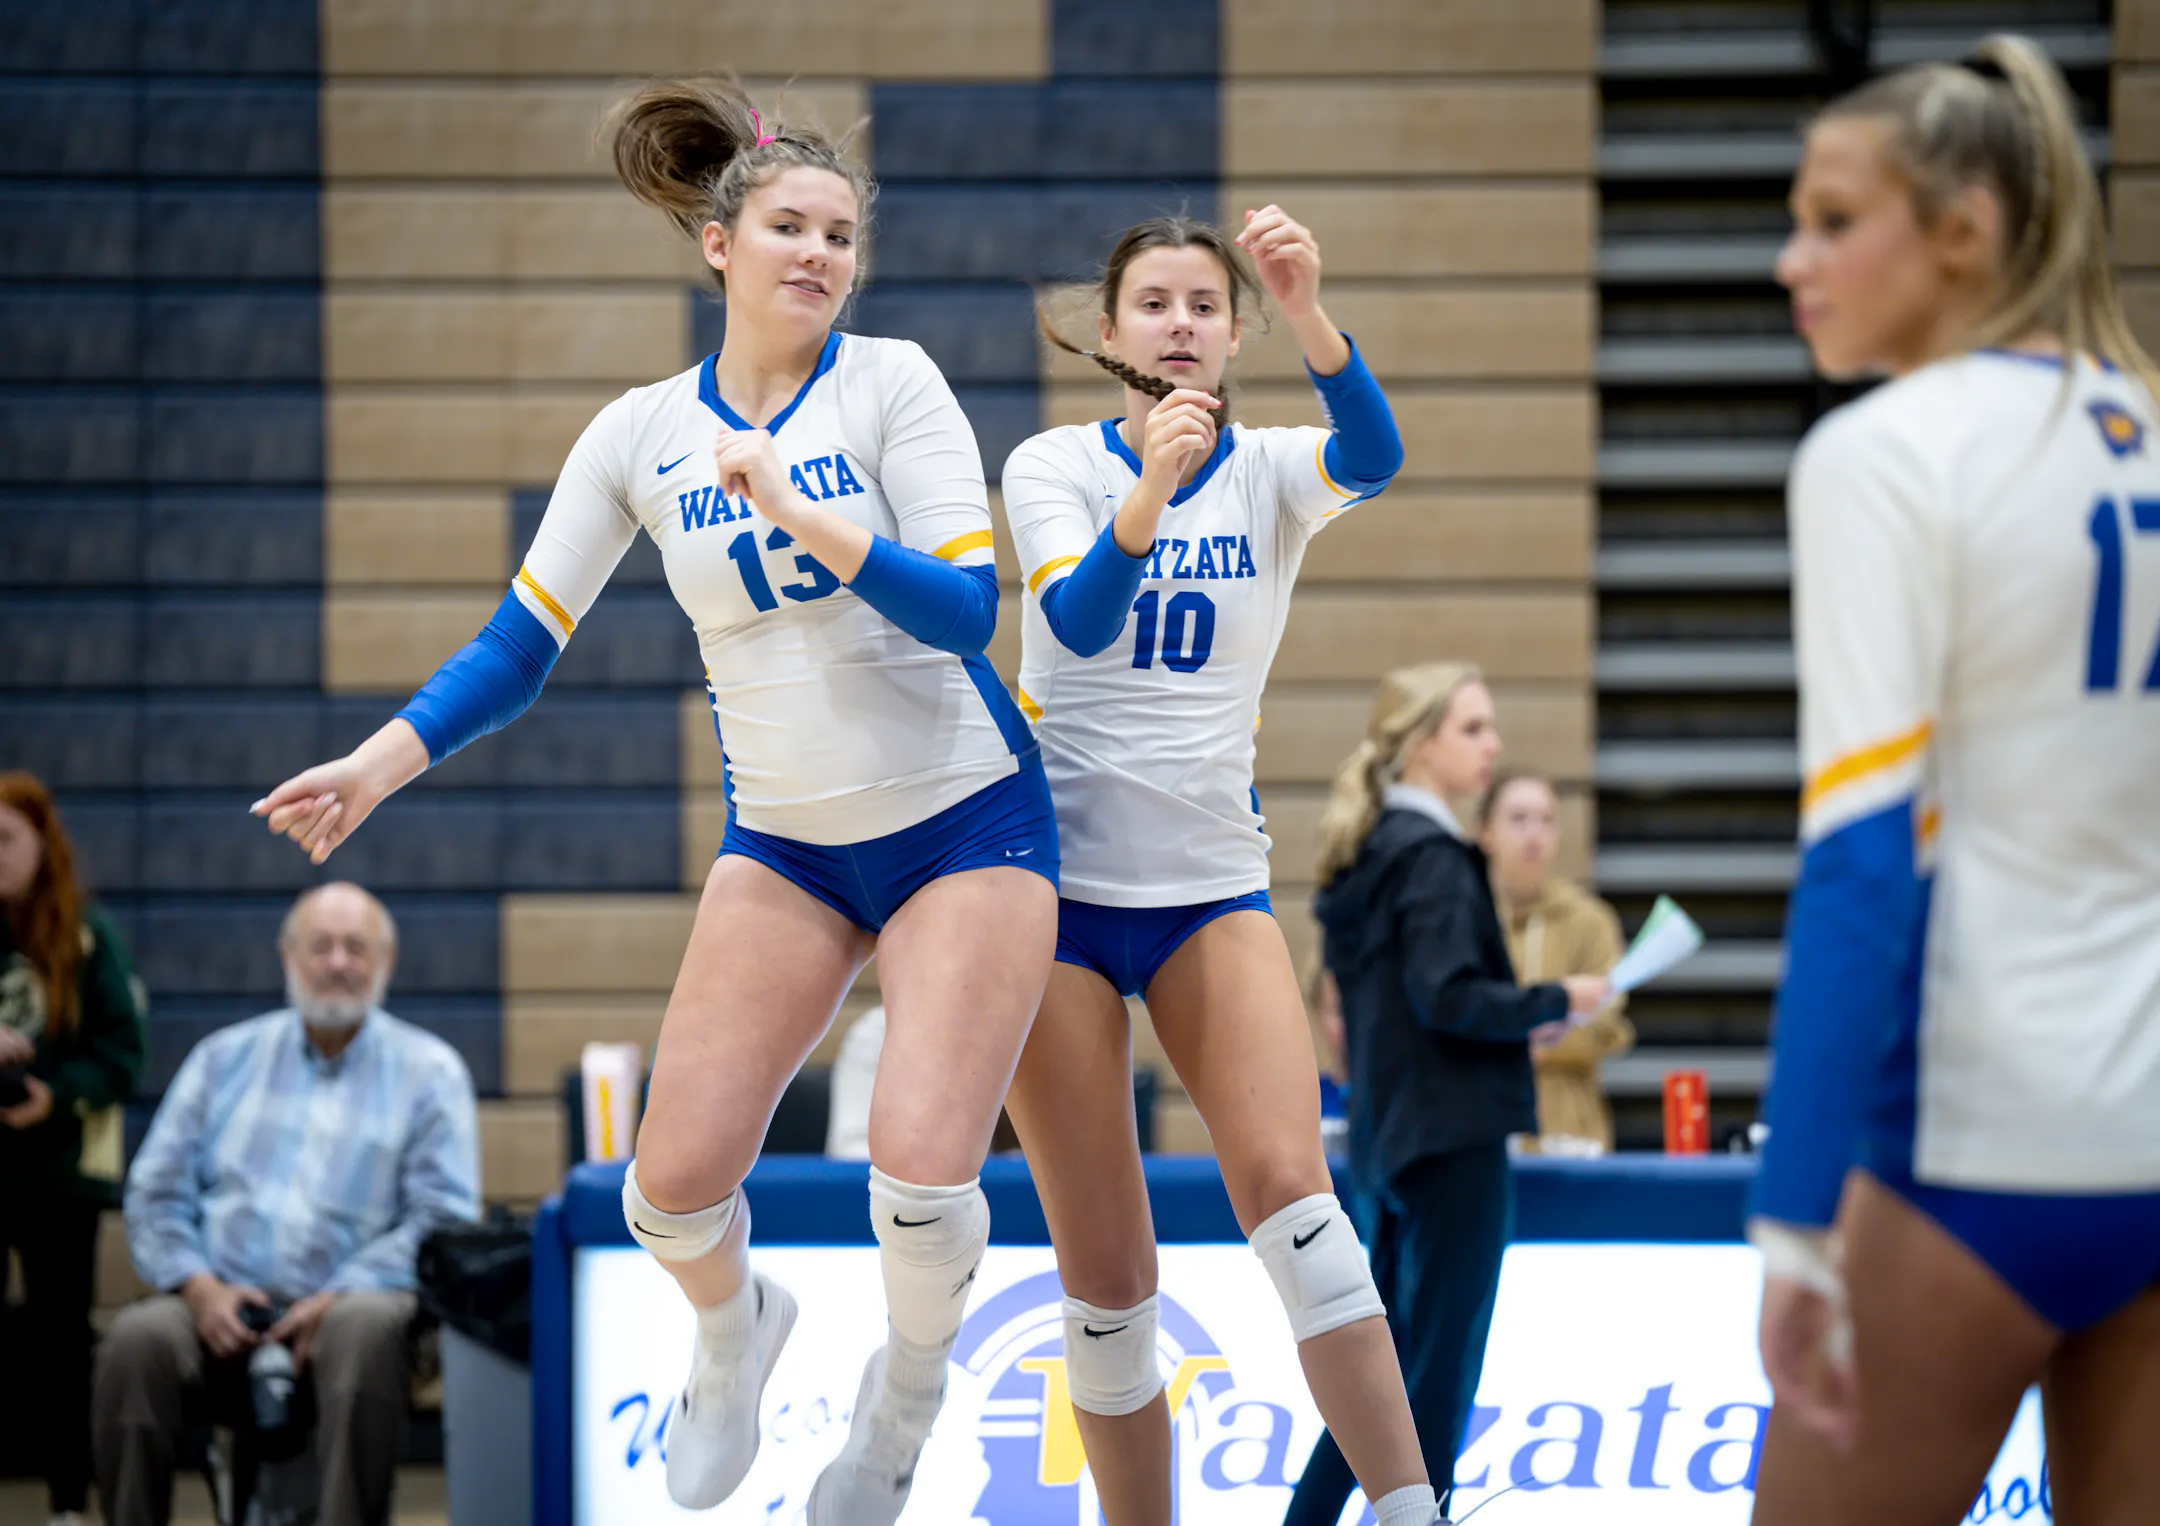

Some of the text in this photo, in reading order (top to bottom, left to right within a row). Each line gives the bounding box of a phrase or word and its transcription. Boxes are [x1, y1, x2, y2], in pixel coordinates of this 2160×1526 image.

[678, 453, 866, 532] WAATA
[727, 526, 841, 612] 13
[1143, 535, 1256, 579] YZATA
[1131, 590, 1216, 673] 10
